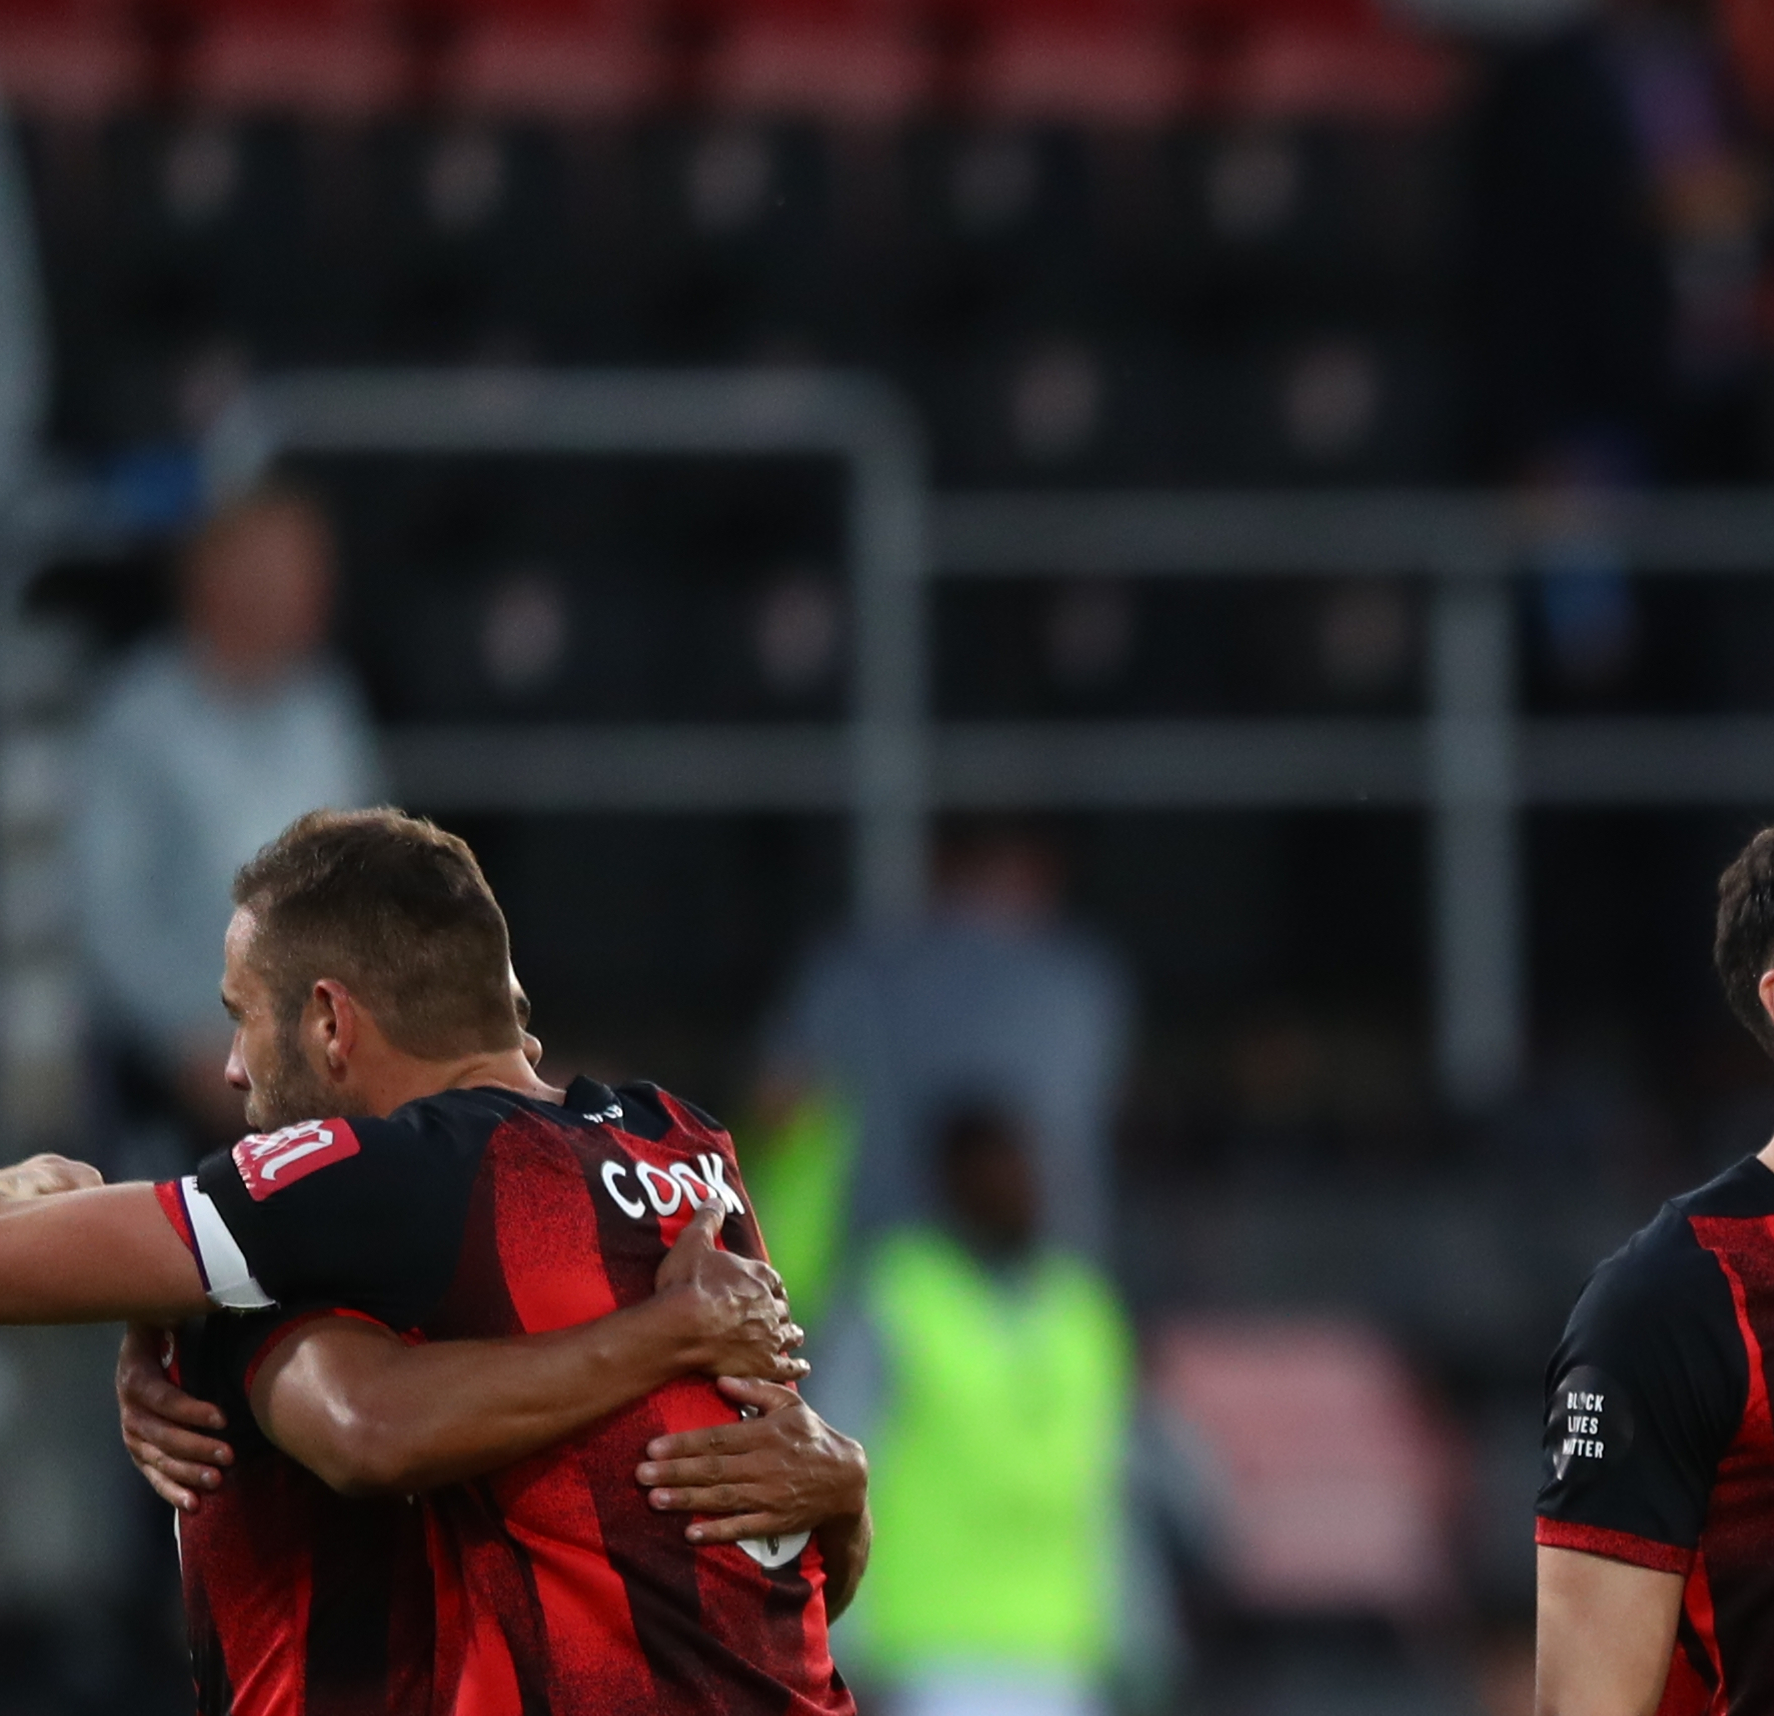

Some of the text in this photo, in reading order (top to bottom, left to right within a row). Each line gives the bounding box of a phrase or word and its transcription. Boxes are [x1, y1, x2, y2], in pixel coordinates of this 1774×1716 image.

[601, 1153, 746, 1219] COOK
[1567, 1391, 1604, 1413] BLCK
[1562, 1438, 1604, 1459] MTTER
